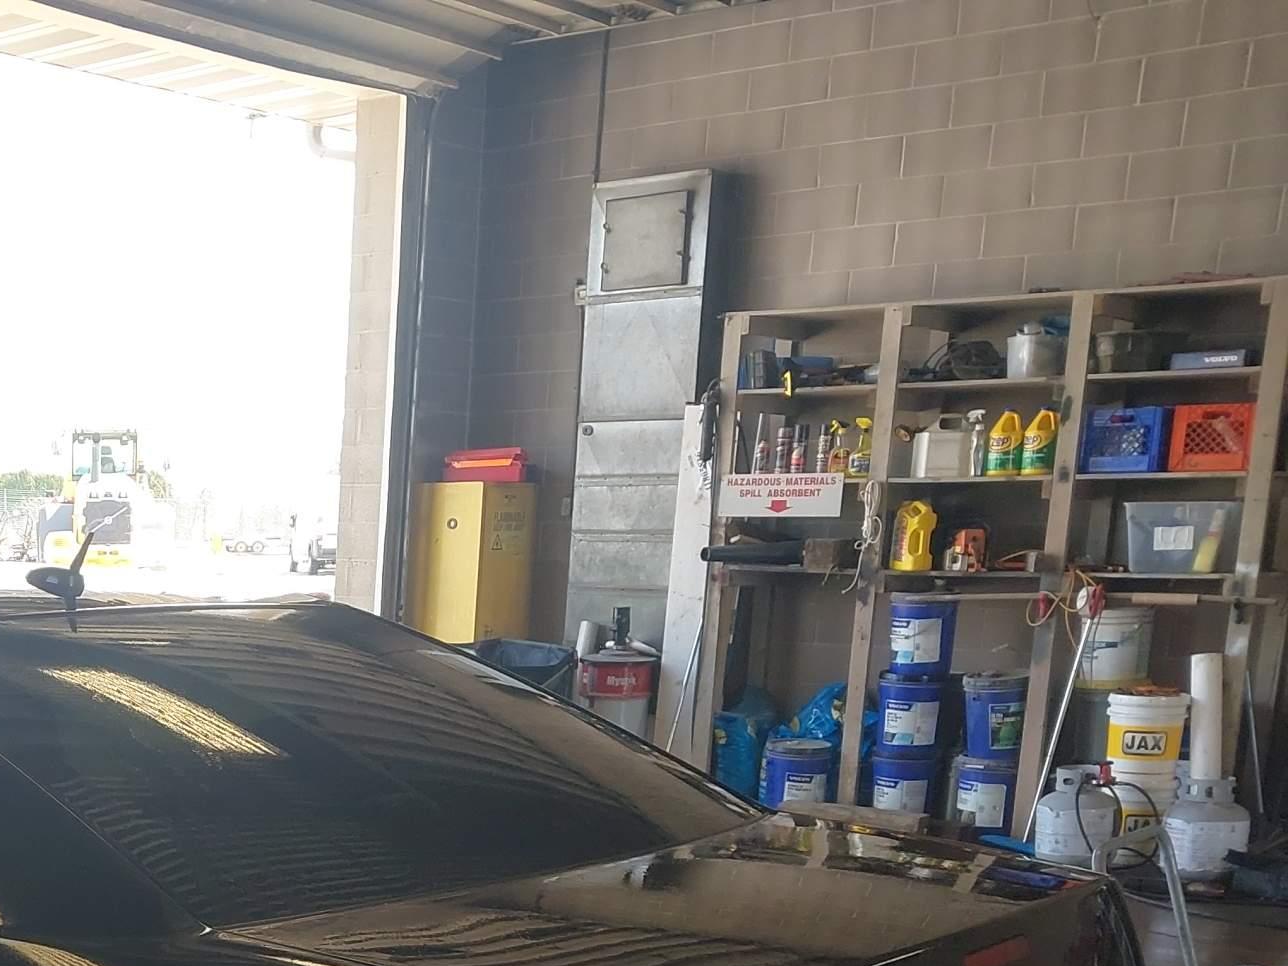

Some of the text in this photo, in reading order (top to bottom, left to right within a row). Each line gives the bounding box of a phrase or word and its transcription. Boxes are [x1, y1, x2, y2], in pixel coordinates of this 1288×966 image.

[1203, 355, 1238, 363] VOLVO
[727, 476, 837, 487] HAZARDOUS MATERIALS
[739, 488, 822, 498] SPILL ABSORBENT
[1125, 734, 1163, 752] JAX
[1127, 817, 1152, 832] JA
